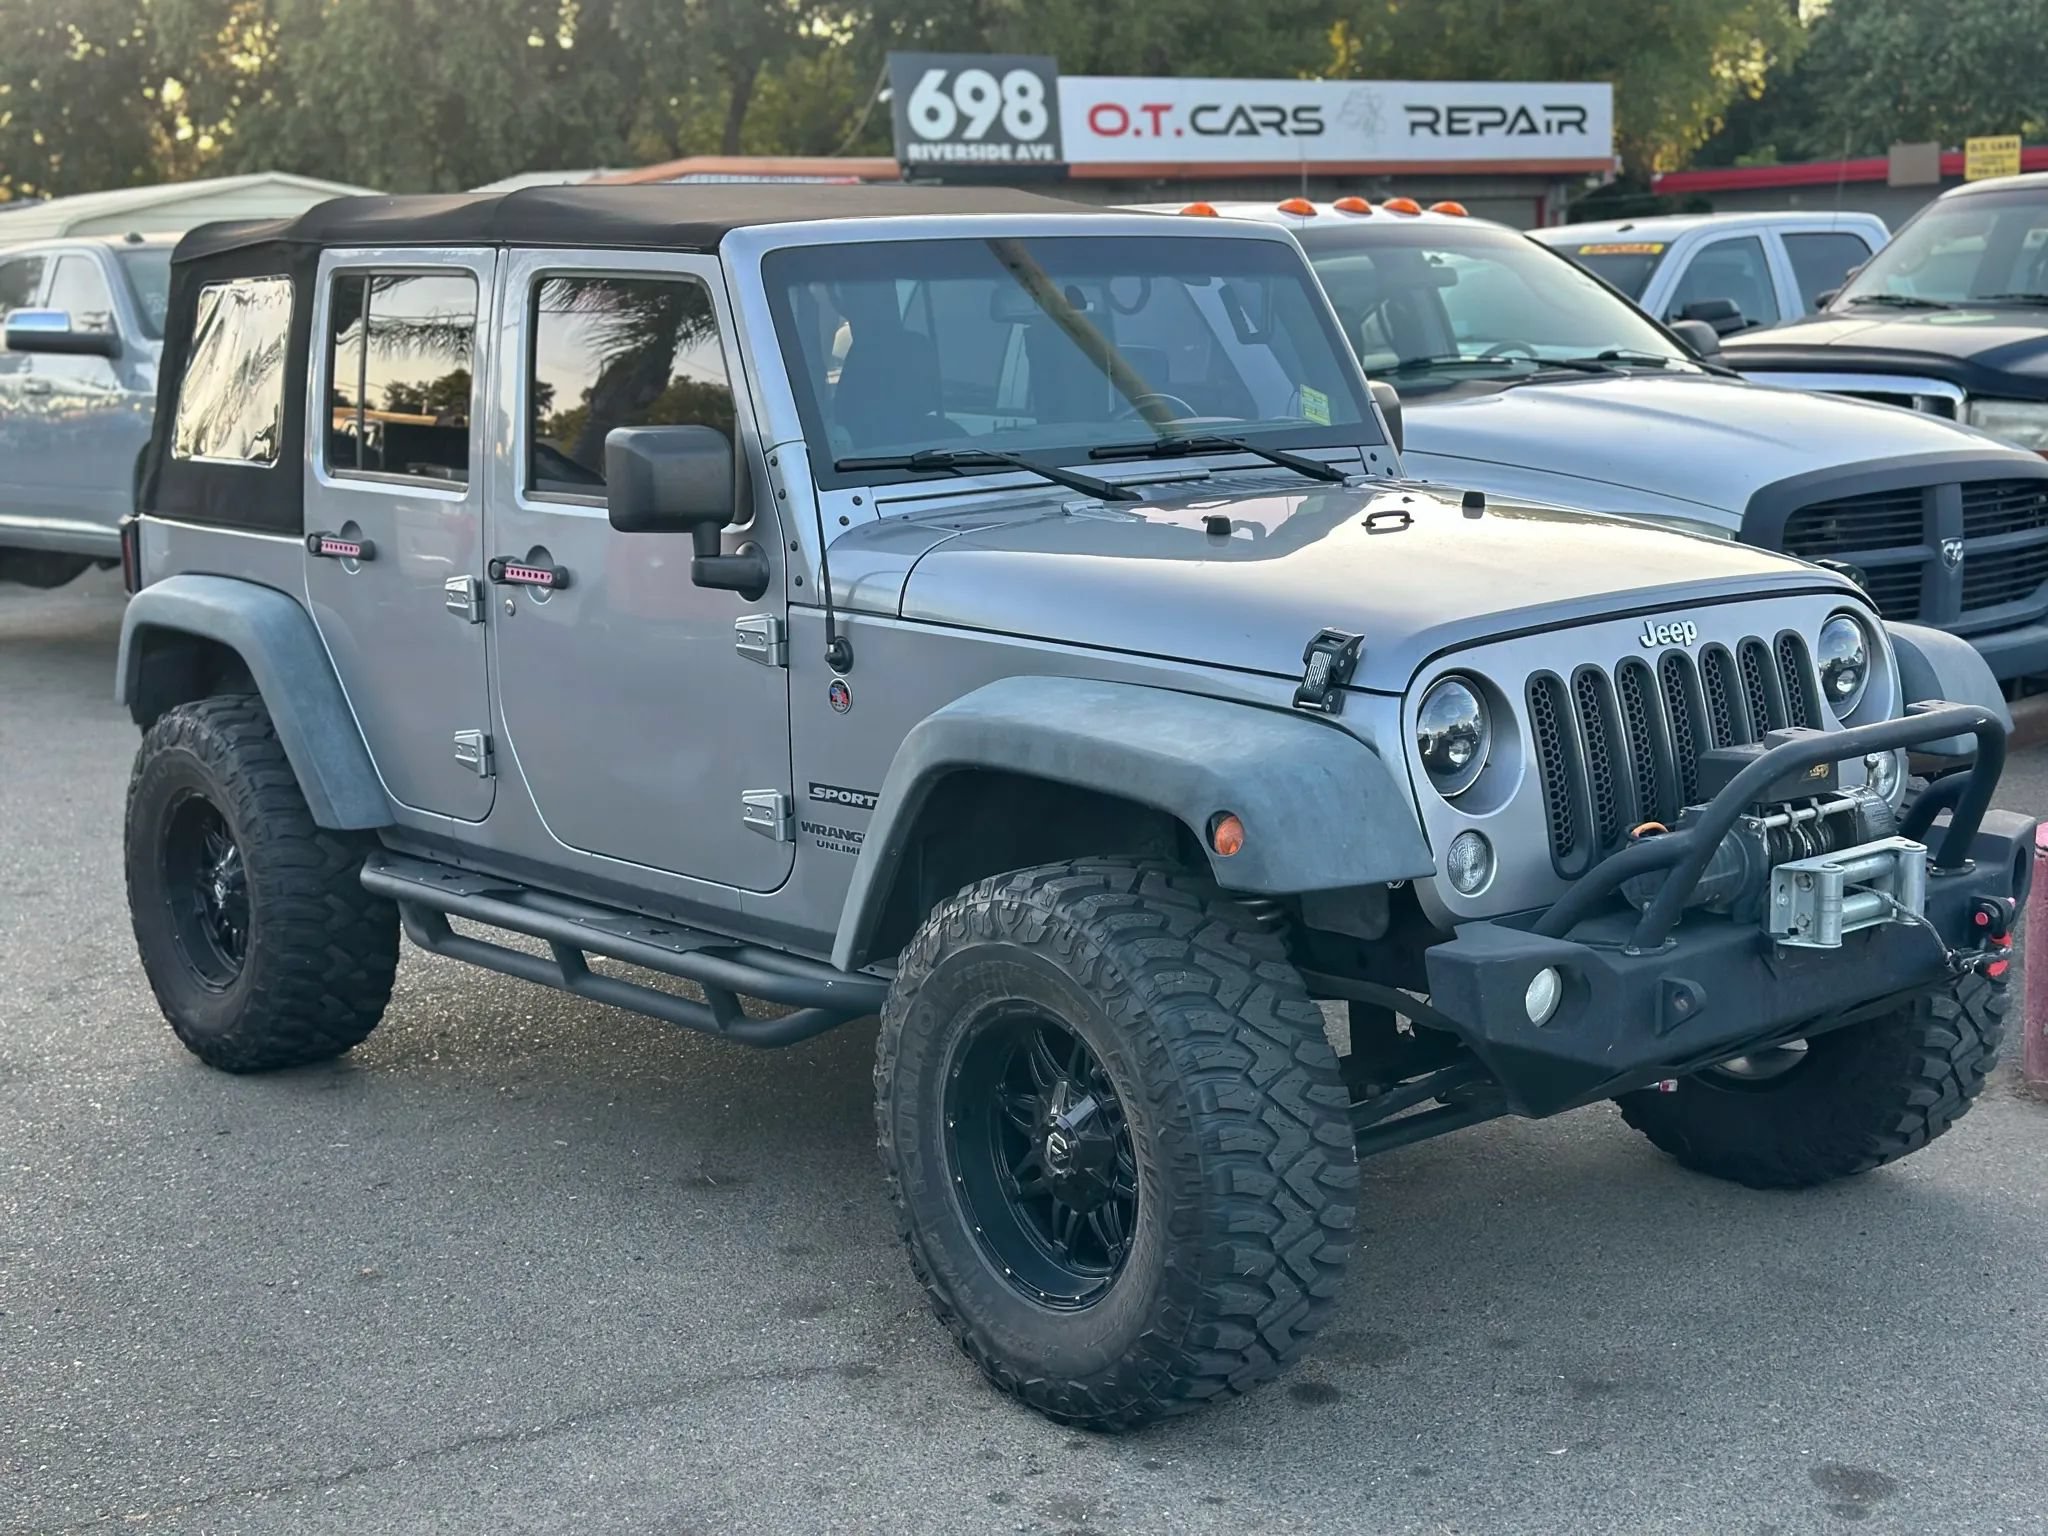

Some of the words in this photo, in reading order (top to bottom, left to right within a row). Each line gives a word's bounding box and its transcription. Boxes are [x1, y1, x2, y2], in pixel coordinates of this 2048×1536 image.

[907, 69, 1048, 141] 698
[1189, 105, 1325, 136] CARS
[1404, 105, 1588, 136] REPAIR
[907, 142, 1012, 161] RIVERSIDE
[1015, 143, 1055, 160] AVE
[1639, 620, 1698, 648] Jeep
[809, 786, 878, 807] SPORT
[801, 820, 866, 844] WRANG
